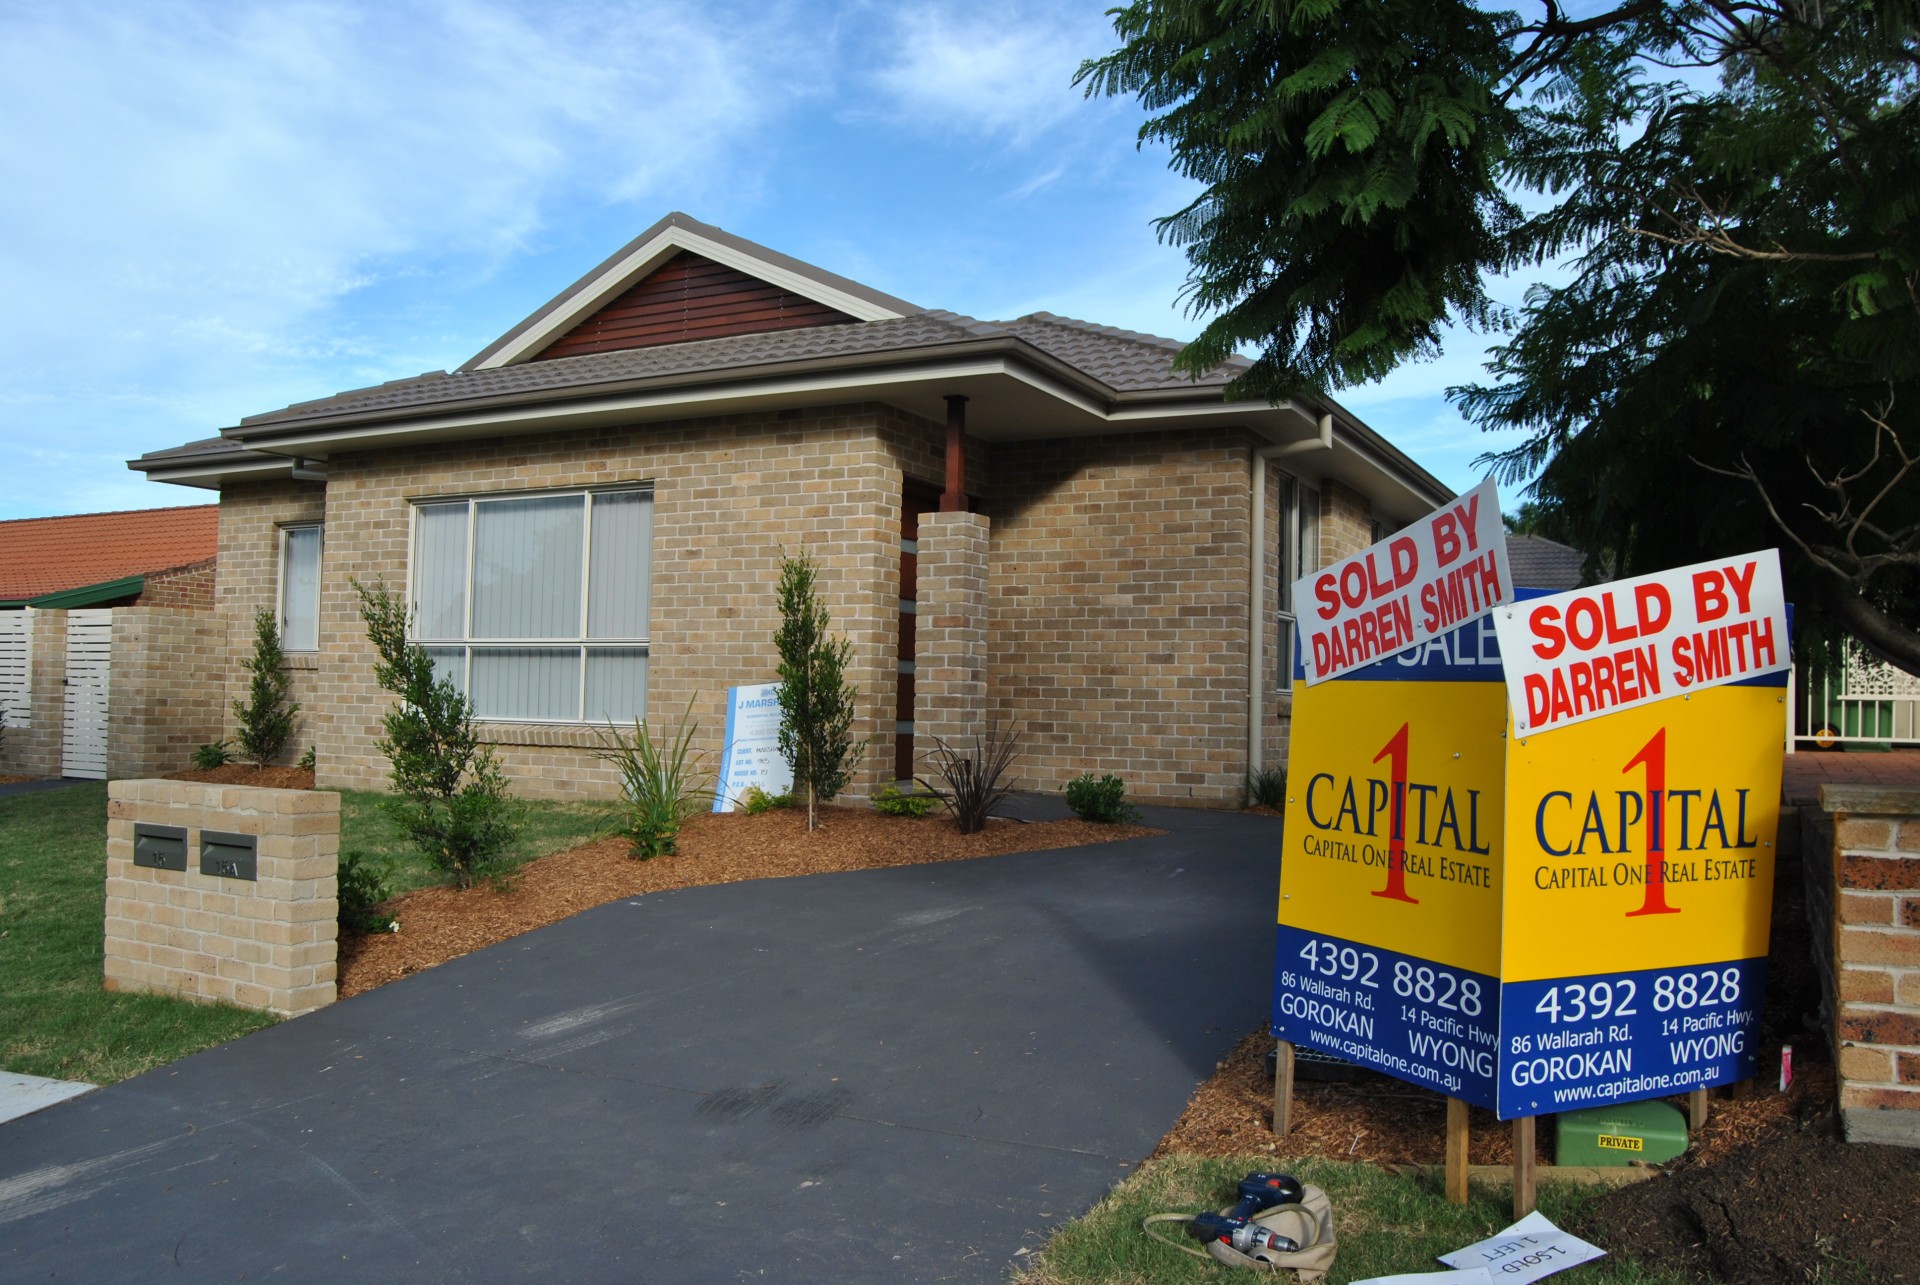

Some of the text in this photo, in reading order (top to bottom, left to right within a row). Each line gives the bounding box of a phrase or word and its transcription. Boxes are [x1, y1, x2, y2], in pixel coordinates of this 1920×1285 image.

[1314, 493, 1479, 621] SOLD BY
[1311, 549, 1502, 679] DARREN SMITH
[1528, 561, 1757, 660] SOLD BY
[1523, 616, 1776, 729] DARREN SMITH
[738, 701, 744, 710] J
[1305, 773, 1490, 857] CAPITAL
[1535, 788, 1758, 857] CAPITAL
[152, 851, 166, 868] 15
[215, 859, 238, 877] 15A
[1303, 834, 1491, 889] CAPITAL ONE REAL ESTATE
[1534, 858, 1756, 891] CAPITAL ONE REAL ESTATE
[1281, 971, 1375, 1011] 86 Wallarah Rd.
[1299, 939, 1482, 1017] 4392 8828
[1535, 967, 1741, 1024] 4392 8828
[1280, 992, 1374, 1040] GOROKAN
[1401, 1005, 1417, 1023] 14
[1421, 1010, 1464, 1038] Pacific
[1662, 1009, 1754, 1036] 14 Pacific Hwy.
[1408, 1029, 1493, 1078] WYONG
[1511, 1024, 1633, 1055] 86 Wallarah Rd.
[1670, 1031, 1744, 1065] WYONG
[1310, 1029, 1461, 1091] www.capitalone.com.au
[1511, 1048, 1632, 1087] GOROKAN
[1554, 1066, 1719, 1103] www.capitalone.com.au
[1600, 1136, 1641, 1149] PRIVATE
[1482, 1241, 1525, 1261] LEFT
[1502, 1250, 1552, 1273] SOLD
